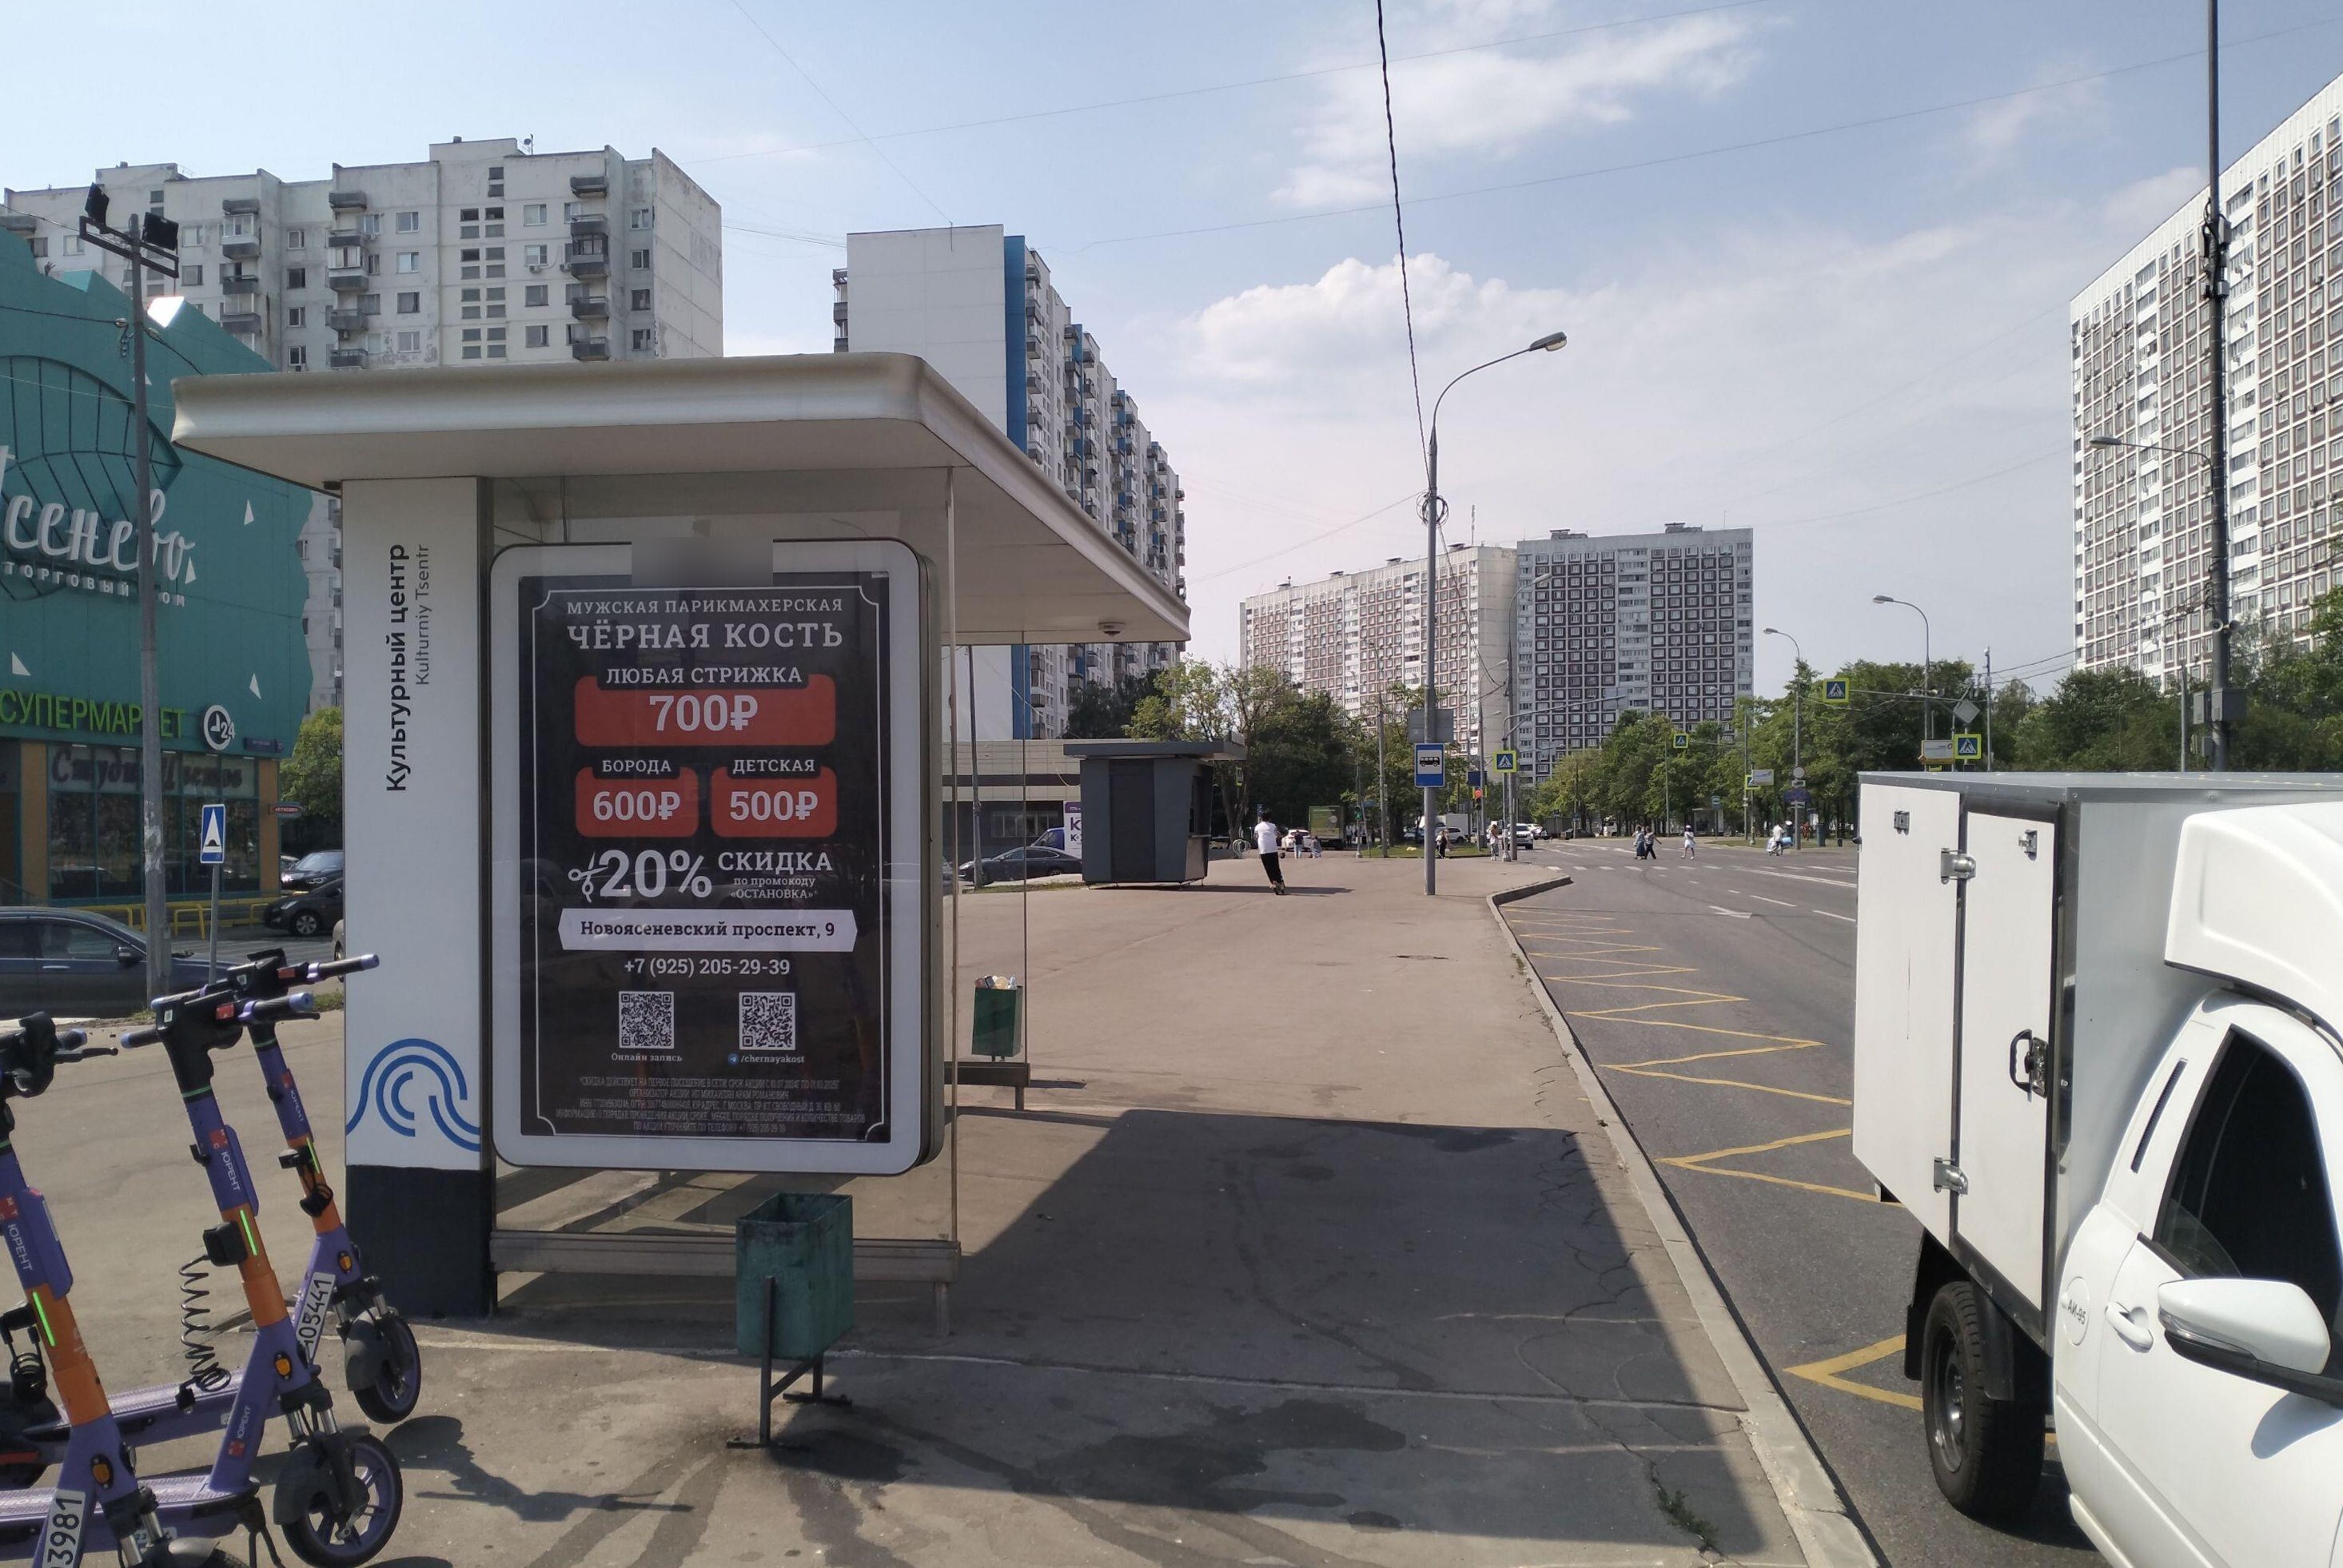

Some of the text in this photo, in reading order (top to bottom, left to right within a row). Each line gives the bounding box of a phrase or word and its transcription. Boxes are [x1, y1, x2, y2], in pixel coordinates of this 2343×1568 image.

[3, 560, 130, 598] ТОРГОВЫЙ
[415, 544, 432, 685] Kulturniy Tsentr
[567, 598, 843, 615] МУЖСКАЯ ПАРИКМАХЕРСКАЯ
[567, 619, 843, 650] ЧЁРНАЯ КОСТЬ
[386, 544, 411, 791] Культурный центр
[606, 667, 802, 685] ЛЮБАЯ СТРИЖКА
[0, 689, 187, 739] СУПЕРМАРЕТ
[649, 694, 759, 731] 700₽
[220, 721, 236, 739] 24
[602, 759, 672, 774] БОРОДА
[732, 759, 815, 774] ДЕТСКАЯ
[592, 790, 681, 821] 600₽
[729, 790, 819, 821] 500₽
[599, 849, 712, 898] 20%
[718, 852, 833, 875] СКИДКА
[751, 878, 816, 888] промокоду
[580, 920, 835, 940] Новоясеневский проспект, 9
[624, 957, 791, 978] +7 (925) 205-29-39
[611, 1053, 683, 1063] Онлайн запись
[740, 1054, 805, 1065] /chernayakost
[221, 1152, 241, 1191] ЮРЕНТ
[7, 1224, 34, 1272] ЮРЕНТ
[2067, 1299, 2086, 1325] АИ-95
[46, 1498, 82, 1568] 3981
